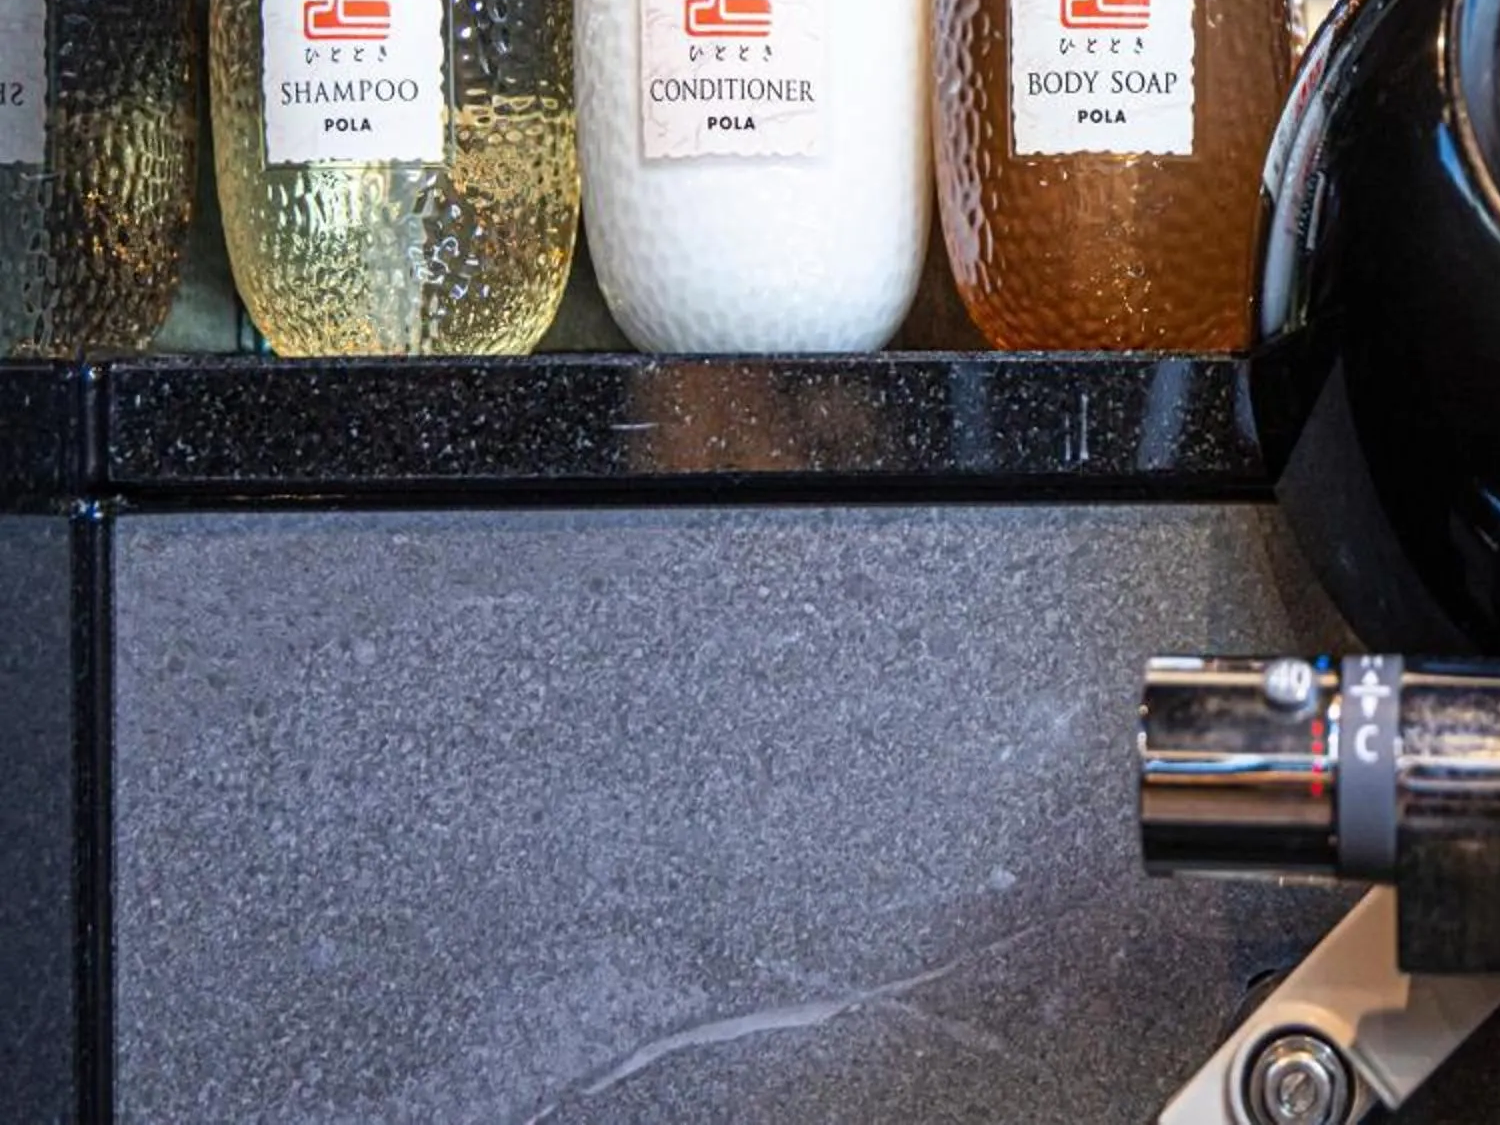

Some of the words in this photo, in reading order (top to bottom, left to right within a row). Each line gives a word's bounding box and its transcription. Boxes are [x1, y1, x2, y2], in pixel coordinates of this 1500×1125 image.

[281, 79, 419, 105] SHAMPOO
[650, 78, 815, 102] CONDITIONER
[1028, 71, 1100, 95] BODY
[1111, 70, 1178, 94] SOAP
[324, 118, 372, 132] POLA
[707, 116, 756, 130] POLA
[1077, 110, 1126, 123] POLA
[1354, 723, 1380, 763] C
